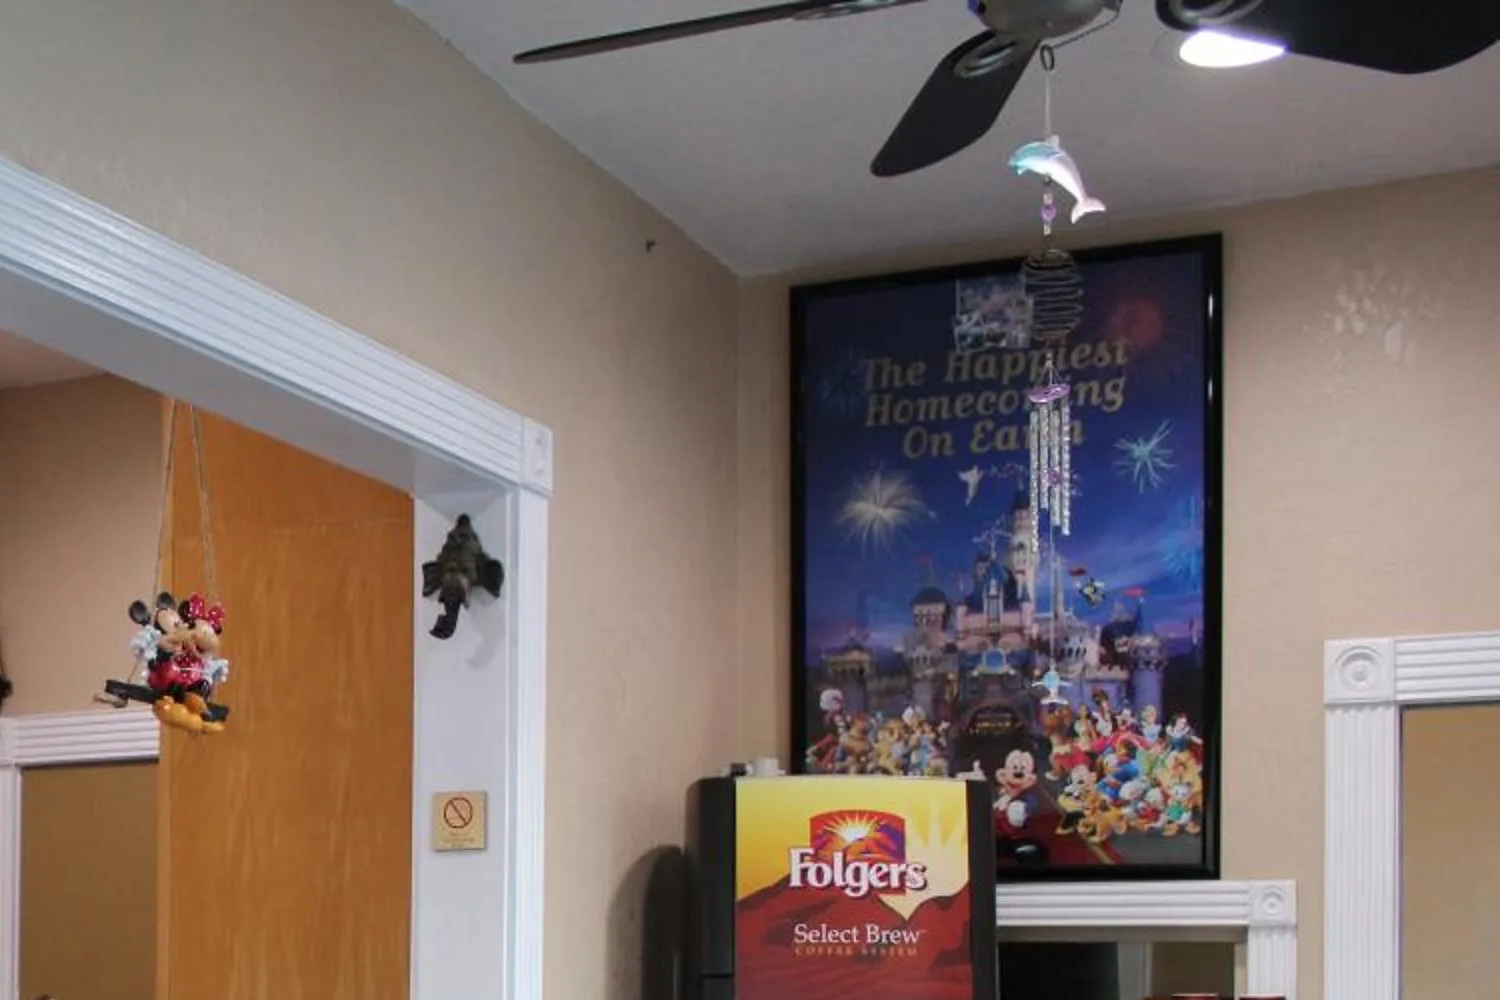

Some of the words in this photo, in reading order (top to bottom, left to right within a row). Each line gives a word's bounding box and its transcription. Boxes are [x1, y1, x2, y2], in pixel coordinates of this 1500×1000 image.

[864, 356, 928, 391] The
[944, 337, 1130, 385] Happiest
[903, 425, 956, 459] On
[788, 847, 928, 898] Folgers
[793, 922, 860, 944] Select
[865, 922, 921, 945] Brew
